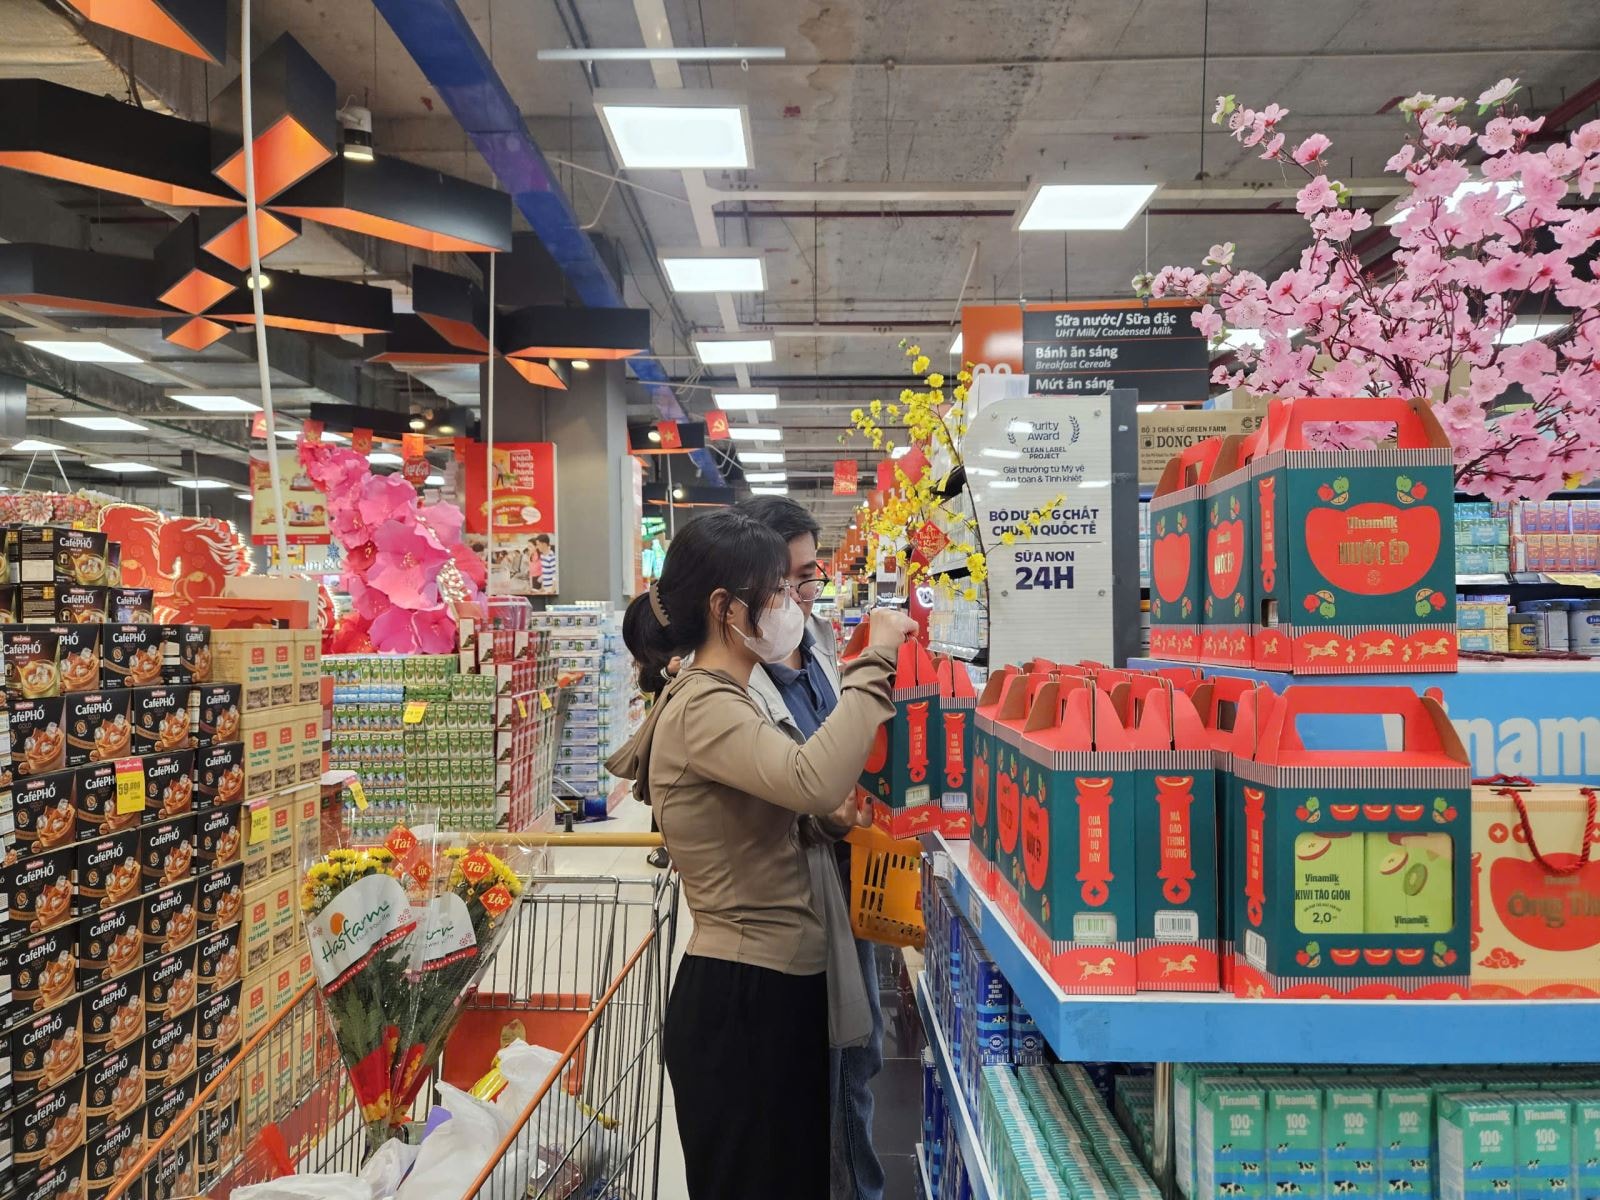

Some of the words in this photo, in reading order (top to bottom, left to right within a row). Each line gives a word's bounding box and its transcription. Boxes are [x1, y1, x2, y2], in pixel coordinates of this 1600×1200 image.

[1055, 314, 1080, 327] Sữa
[1082, 313, 1123, 330] nước/
[1126, 312, 1151, 326] Sữa
[1153, 313, 1177, 328] đặc
[1055, 328, 1073, 337] UHT
[1102, 327, 1151, 336] Condensed
[1152, 326, 1172, 335] Milk
[1035, 344, 1067, 358] Bánh
[1069, 346, 1087, 358] ăn
[1089, 345, 1118, 360] sáng
[1035, 361, 1076, 370] Breakfast
[1078, 360, 1112, 368] Cereals
[1035, 377, 1065, 390] Mứt
[1066, 378, 1084, 390] ăn
[1086, 377, 1114, 390] sáng
[1028, 432, 1060, 441] Award
[1157, 436, 1192, 448] DONG
[989, 508, 1009, 522] BỘ
[1062, 506, 1100, 520] CHẤT
[1040, 521, 1078, 536] QUỐC
[1080, 521, 1096, 535] TẾ
[59, 536, 92, 548] CaféPHỐ
[1015, 551, 1044, 563] SỮA
[1045, 550, 1075, 562] NON
[1016, 566, 1074, 590] 24H
[61, 593, 94, 605] CaféPHỐ
[116, 594, 142, 606] CaféPHỐ
[112, 630, 146, 643] CaféPHỐ
[3, 640, 41, 656] CaféPHỐ
[142, 692, 176, 709] CaféPHỐ
[206, 689, 231, 704] CaféPHỐ
[9, 704, 46, 724] aféPHỐ
[75, 698, 114, 716] CaféPHỐ
[205, 749, 232, 767] CaféPHỐ
[148, 760, 180, 778] CaféPHỐ
[16, 782, 57, 804] CaféPHỐ
[204, 812, 230, 832] CaféPHỐ
[150, 826, 180, 847] CaféPHỐ
[392, 838, 411, 850] Tài
[87, 841, 124, 865] CaféPHỐ
[16, 859, 55, 886] CaféPHỐ
[467, 861, 486, 873] Tài
[203, 872, 232, 893] CaféPHỐ
[1305, 874, 1339, 883] Vinamilk
[150, 890, 182, 914] CaféPHỐ
[488, 892, 507, 906] Lộc
[1296, 890, 1313, 900] KIWI
[90, 912, 126, 937] CaféPHỐ
[1313, 912, 1332, 924] 2,0
[322, 900, 390, 963] Hasfarm
[18, 938, 56, 966] CaféPHỐ
[203, 934, 230, 956] CaféPHỐ
[152, 958, 182, 982] CaféPHỐ
[92, 984, 128, 1012] CaféPHỐ
[203, 996, 230, 1020] CaféPHỐ
[22, 1014, 63, 1046] CaféPHỐ
[152, 1024, 182, 1050] CaféPHỐ
[94, 1056, 128, 1084] CaféPHỐ
[24, 1090, 66, 1127] CaféPHỐ
[154, 1089, 185, 1118] CaféPHỐ
[1219, 1095, 1261, 1106] Vinamilk
[1275, 1095, 1317, 1106] Vinamilk
[1469, 1111, 1510, 1122] Vinamilk
[1524, 1110, 1566, 1121] Vinamilk
[96, 1124, 131, 1157] CaféPHỐ
